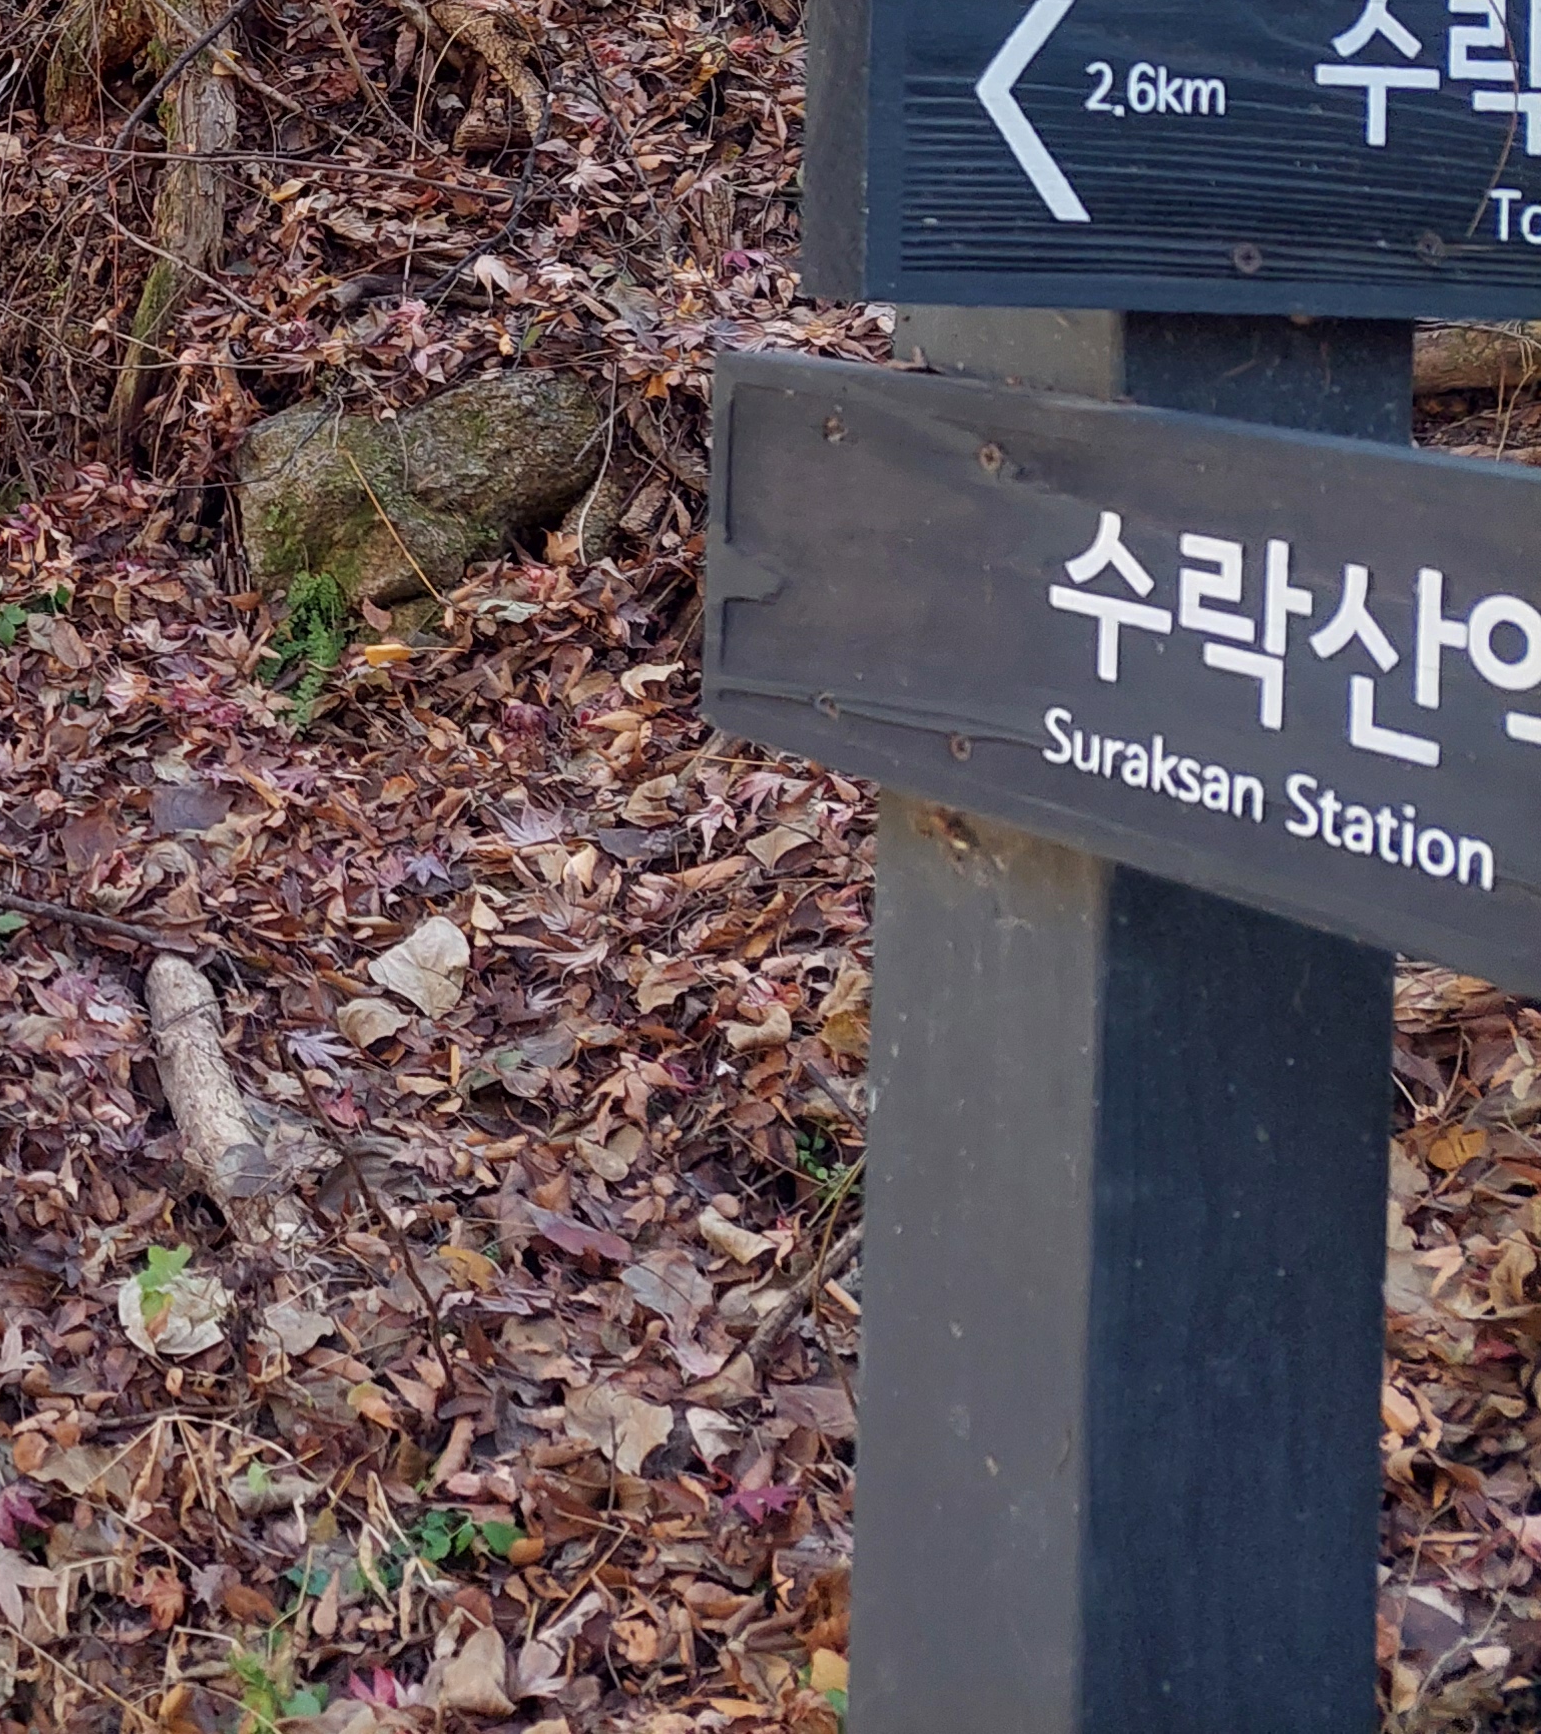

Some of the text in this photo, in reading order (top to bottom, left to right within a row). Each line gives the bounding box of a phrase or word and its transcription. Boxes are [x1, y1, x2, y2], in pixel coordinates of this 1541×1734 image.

[1084, 61, 1226, 117] 2.6km
[1042, 707, 1495, 892] Suraksan Station
